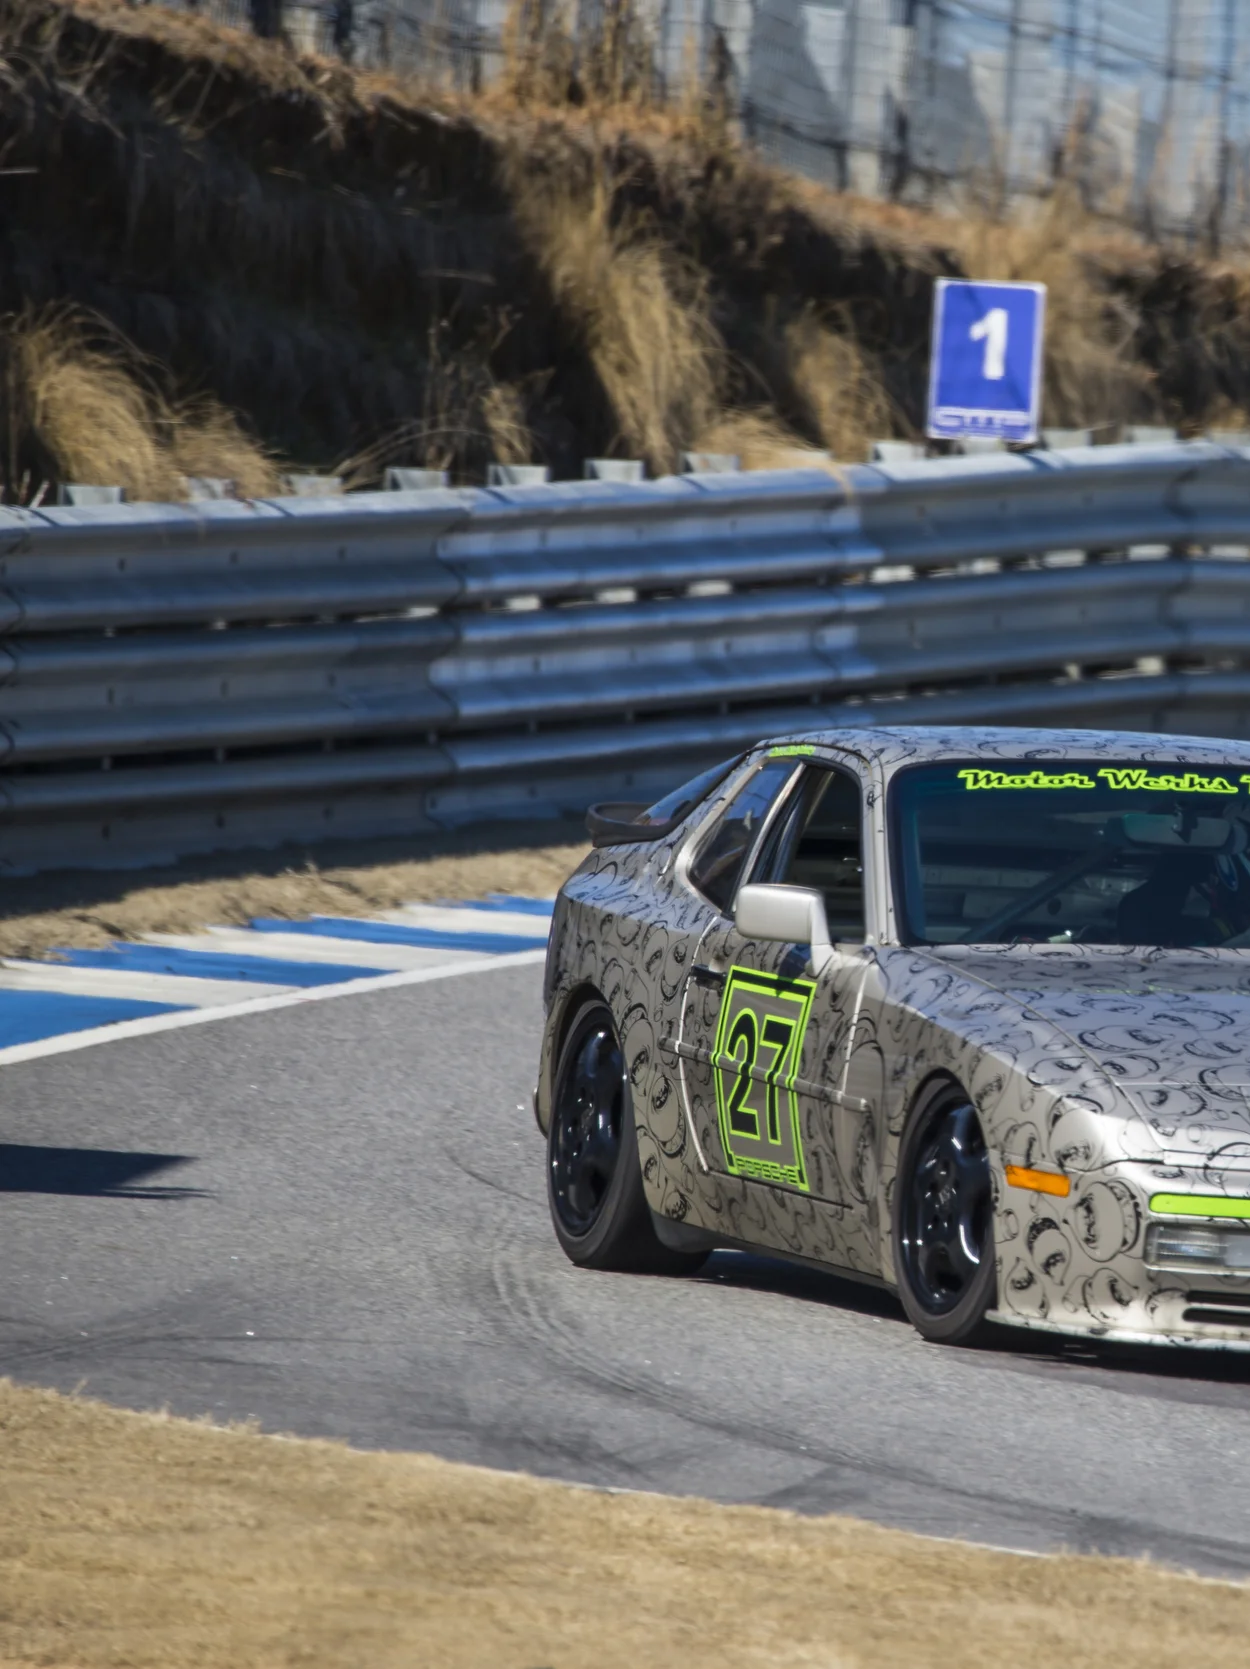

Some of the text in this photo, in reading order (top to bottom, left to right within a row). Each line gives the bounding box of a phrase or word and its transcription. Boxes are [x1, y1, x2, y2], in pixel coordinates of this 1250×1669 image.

[968, 307, 1009, 381] 1
[957, 769, 1096, 790] Motor
[1097, 768, 1239, 794] Works
[725, 1007, 797, 1146] 27
